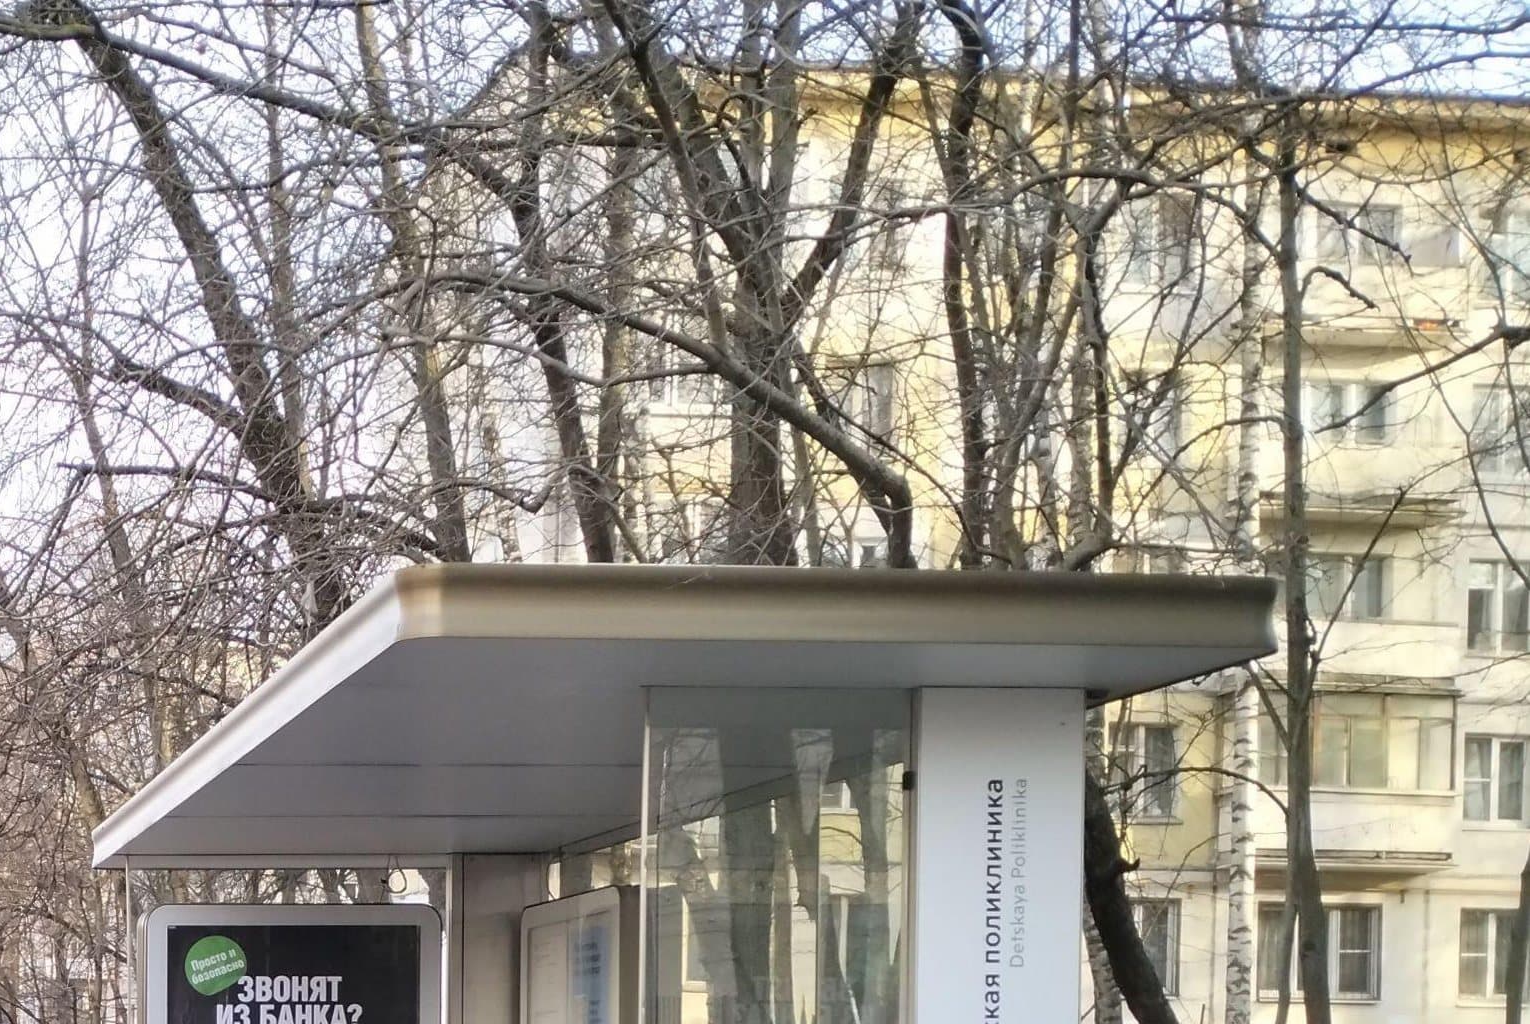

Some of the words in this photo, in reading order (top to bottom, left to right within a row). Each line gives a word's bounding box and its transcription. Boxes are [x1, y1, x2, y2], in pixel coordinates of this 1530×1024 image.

[1011, 777, 1028, 879] Poliklinika
[985, 778, 1003, 964] поликлиника
[1009, 884, 1026, 968] Detskaya
[190, 951, 228, 972] Просто
[228, 949, 237, 959] и
[191, 959, 245, 985] безопасно
[237, 975, 343, 1003] ЗВОНЯТ
